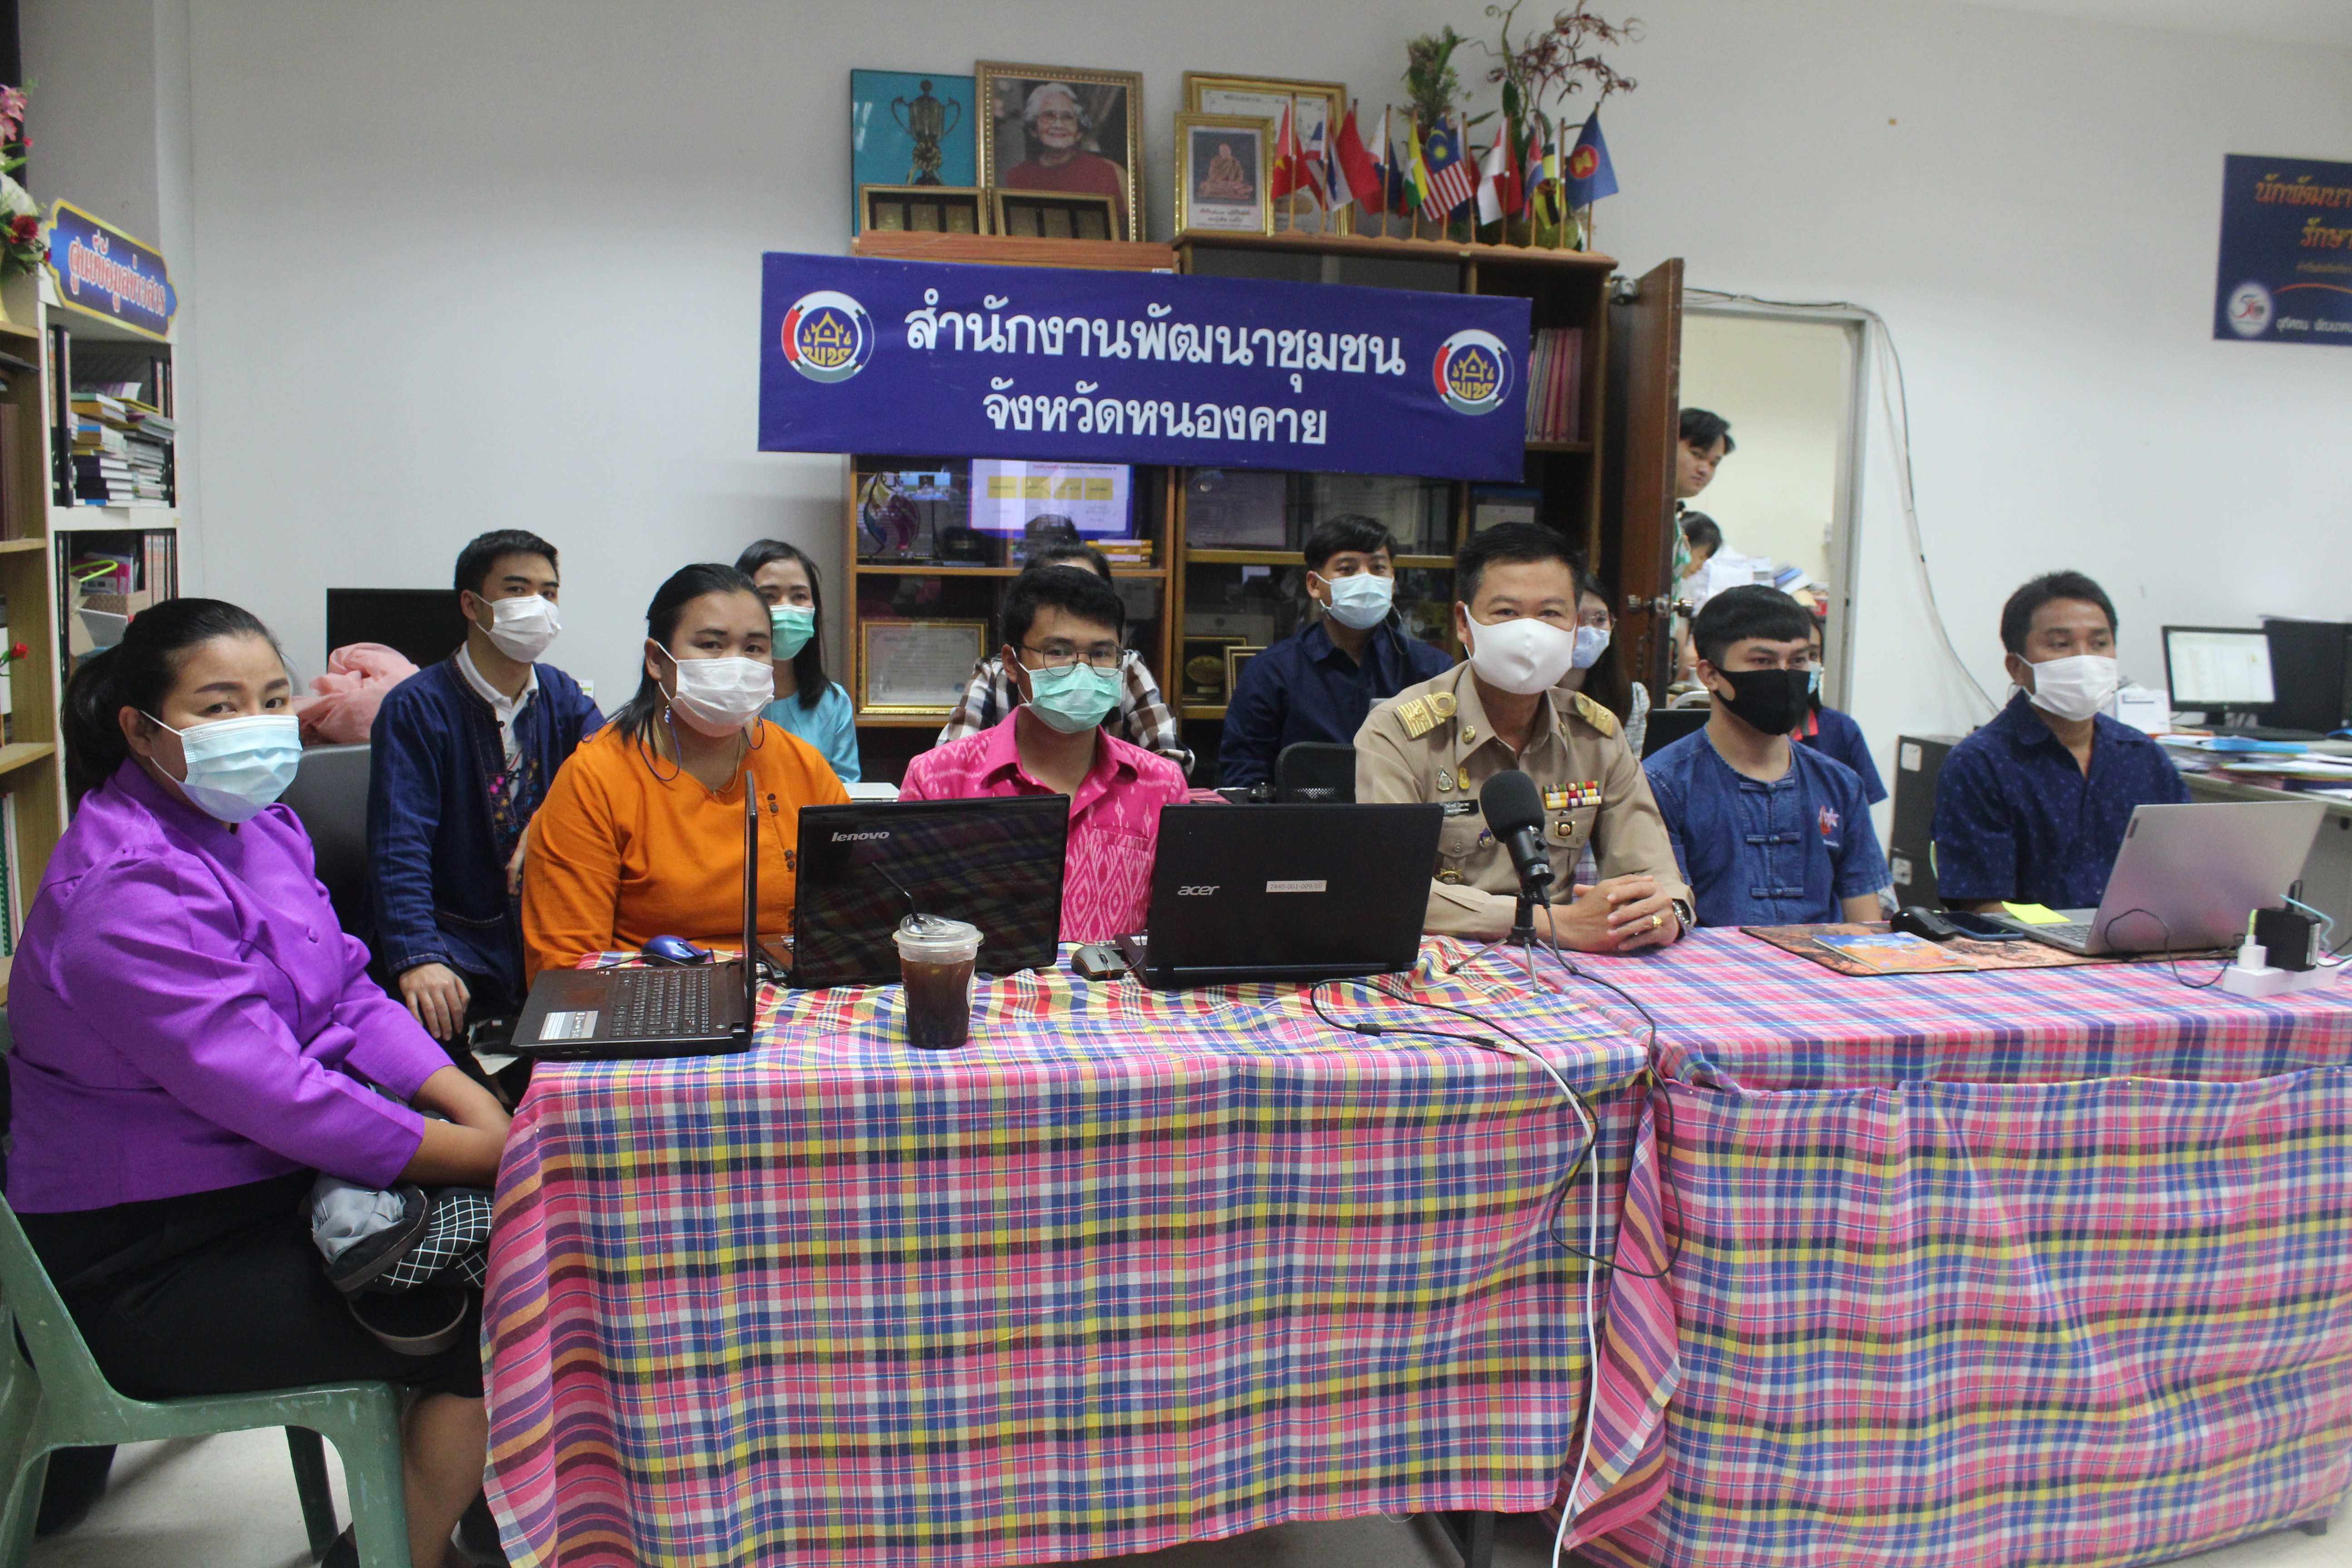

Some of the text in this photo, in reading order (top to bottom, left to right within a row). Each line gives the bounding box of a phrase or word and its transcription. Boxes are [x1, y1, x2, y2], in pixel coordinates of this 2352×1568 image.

[69, 229, 166, 317] ศูนย์ข้อมูลข่าวสาร
[904, 288, 1406, 393] สำนักงานพัฒนาชุมชน
[983, 377, 1327, 445] จังหวัดหนองคาย
[831, 831, 890, 842] lenovo
[1177, 886, 1220, 896] acer
